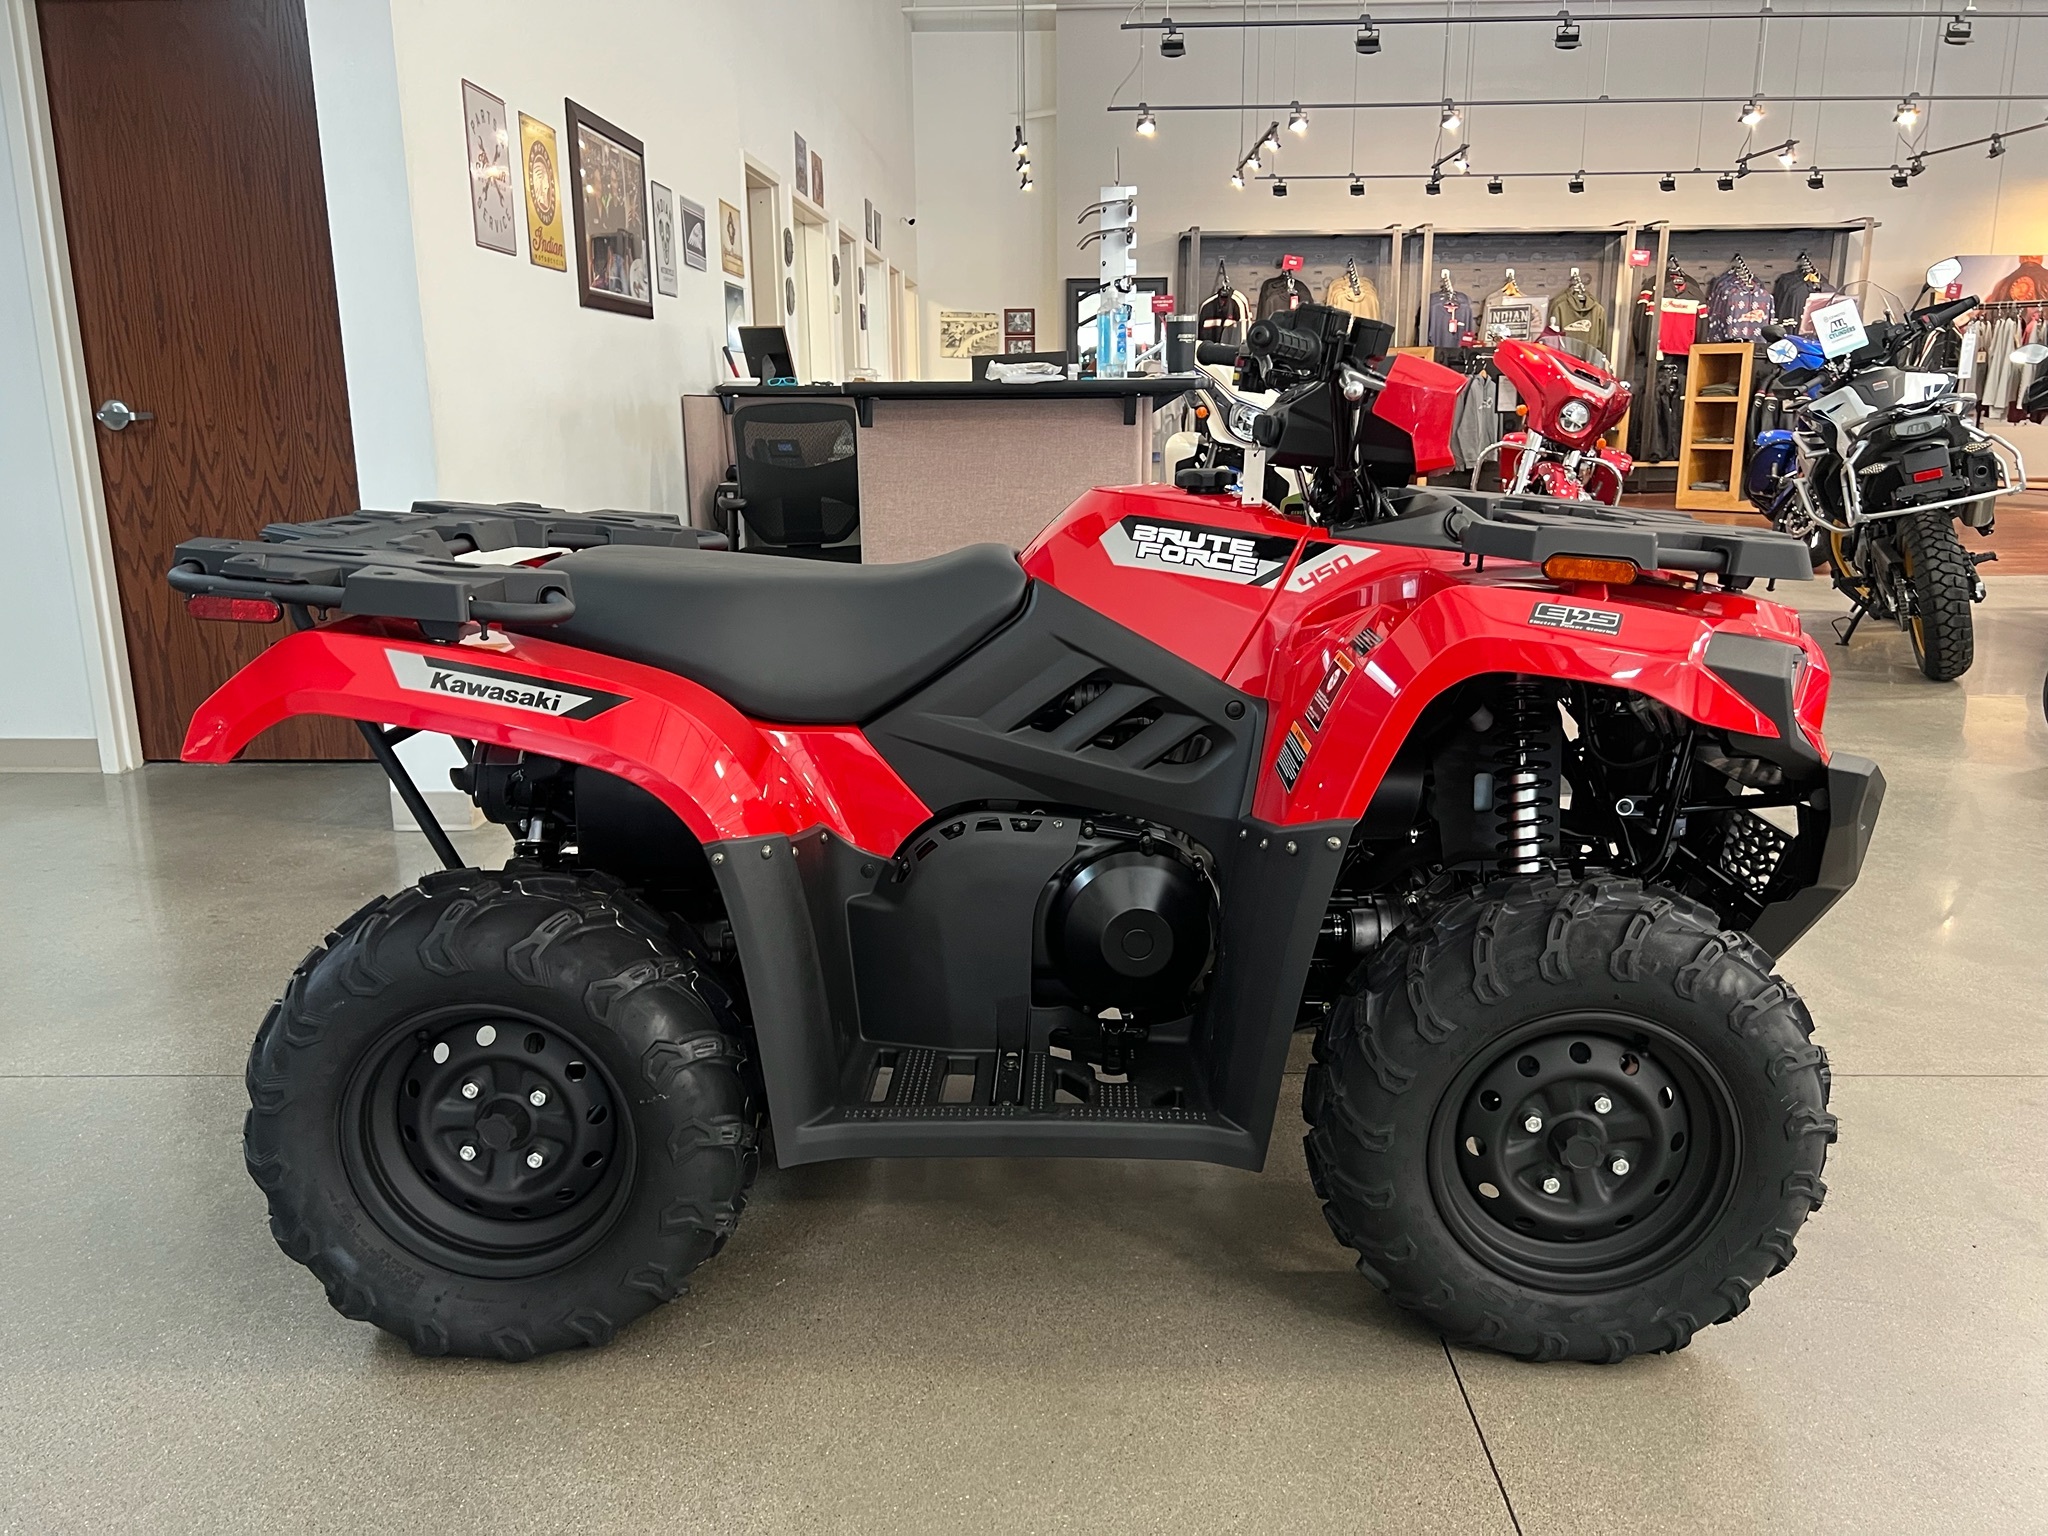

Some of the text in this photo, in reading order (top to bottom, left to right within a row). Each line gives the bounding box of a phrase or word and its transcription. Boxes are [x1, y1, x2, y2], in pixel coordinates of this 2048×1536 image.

[470, 108, 497, 135] PARTS
[476, 196, 512, 233] SERVICE
[532, 226, 564, 257] Indian
[1489, 309, 1529, 324] INDIAN
[1830, 318, 1848, 333] ALL
[1828, 325, 1856, 340] CYLINDERS
[1132, 523, 1256, 556] BRUTE
[1135, 540, 1260, 576] FORCE
[1296, 553, 1352, 587] 450
[1528, 619, 1557, 627] Electric
[1585, 626, 1618, 636] Steering
[1534, 603, 1620, 628] EPS
[429, 671, 562, 712] Kawasaki
